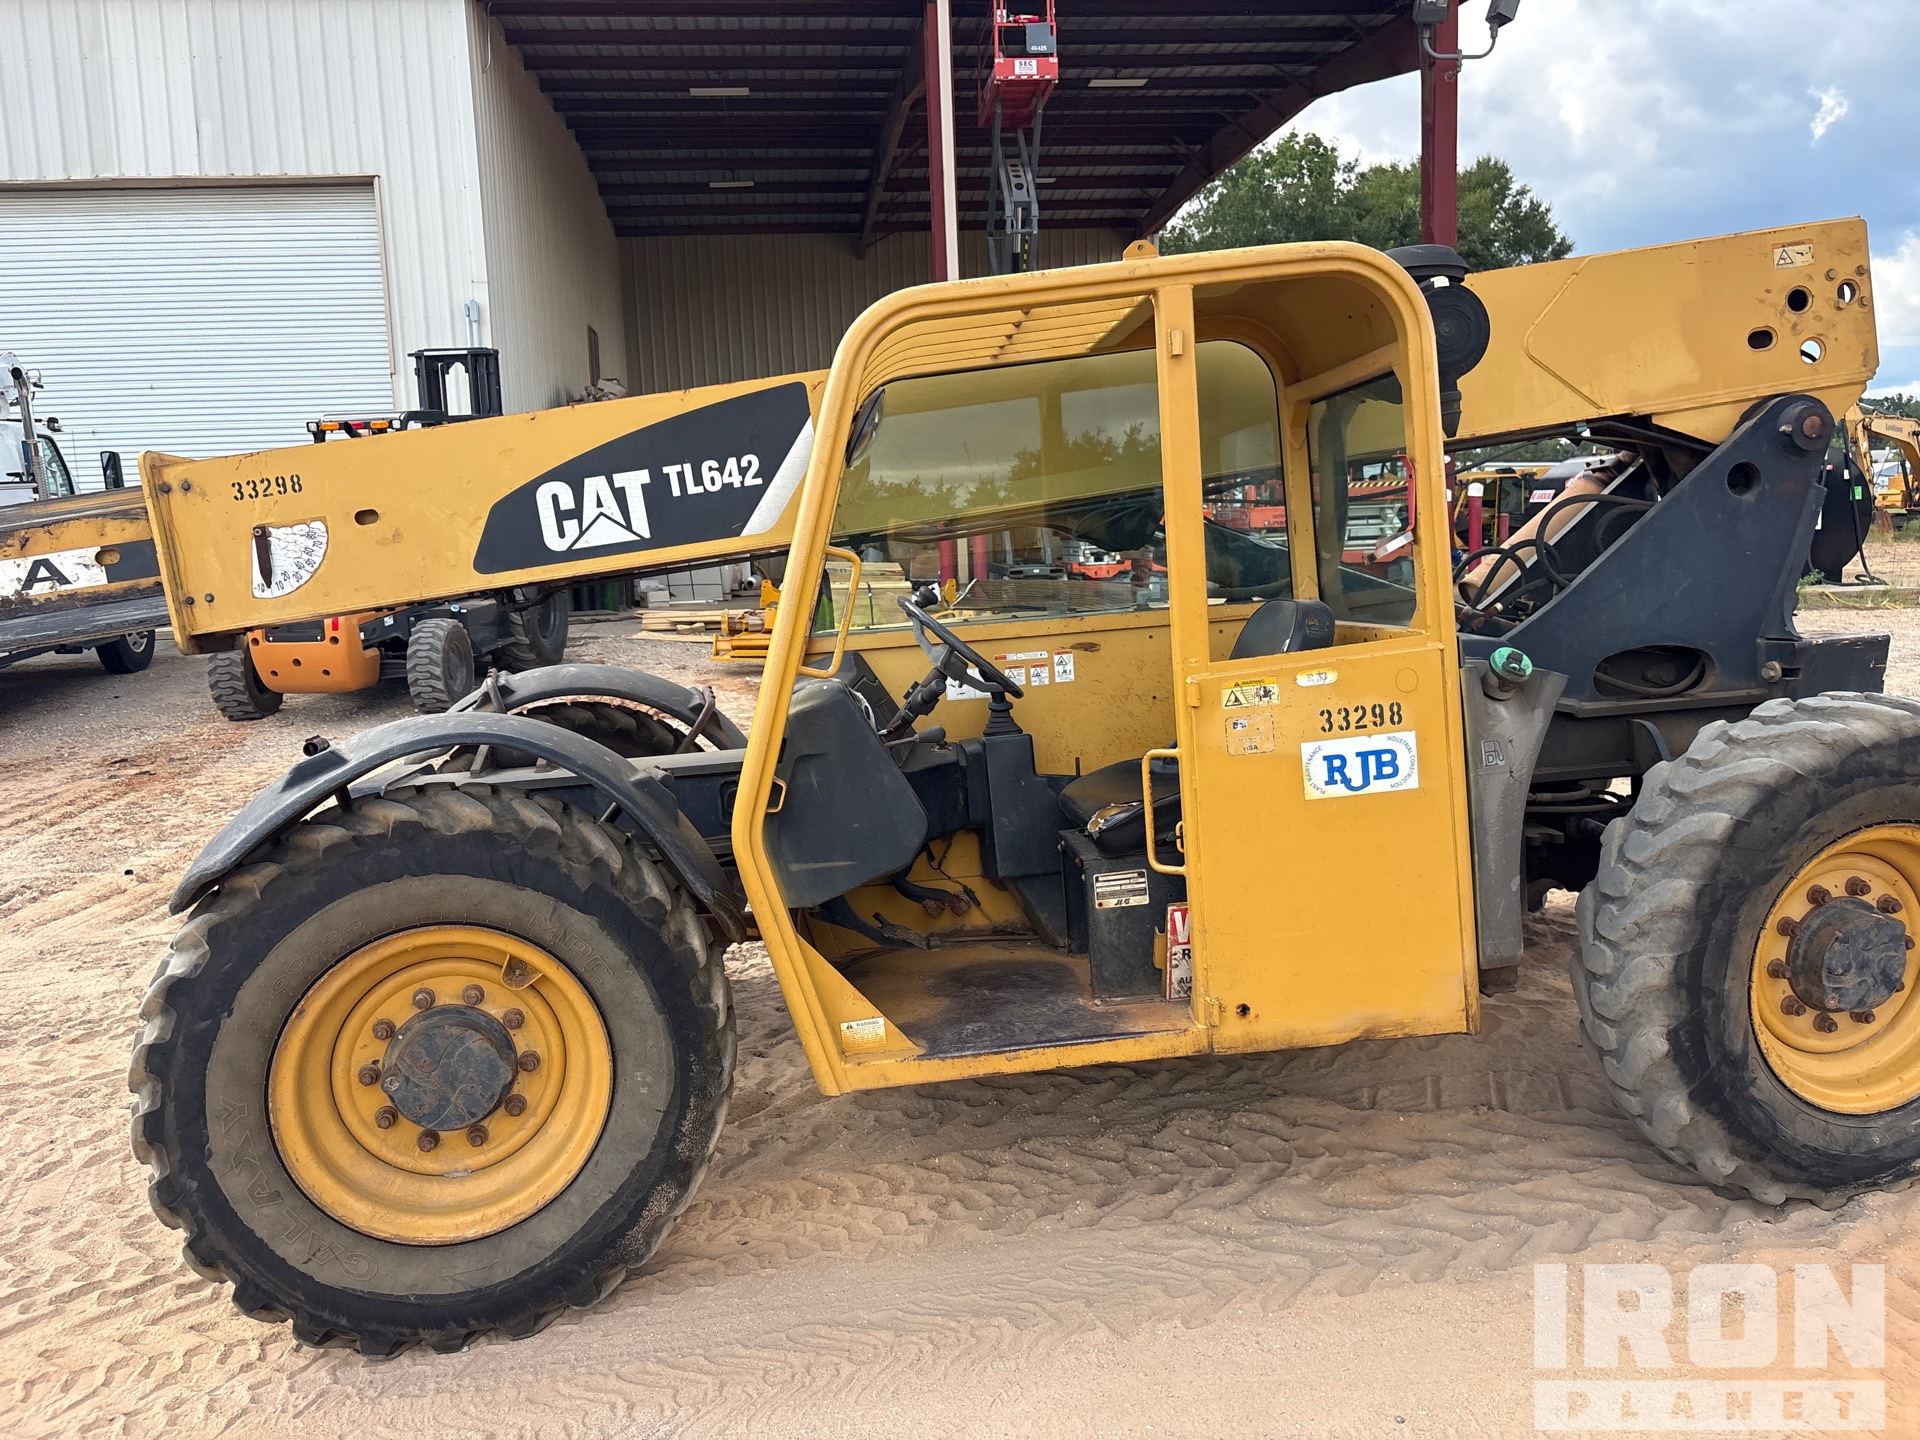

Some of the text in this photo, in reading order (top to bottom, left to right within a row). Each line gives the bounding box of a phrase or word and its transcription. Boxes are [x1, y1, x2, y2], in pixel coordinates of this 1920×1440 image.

[231, 474, 303, 501] 33298
[536, 454, 763, 551] CAT TL642
[275, 580, 285, 591] 10
[281, 570, 291, 582] 20
[1319, 701, 1403, 733] 33298
[1304, 745, 1326, 795] PLANT MAINTENANCE
[1322, 748, 1400, 792] RJB
[1386, 735, 1416, 789] INDUSTRIAL CONSTRUCTION
[856, 1019, 880, 1028] WARNING
[219, 1095, 378, 1281] GALAXY
